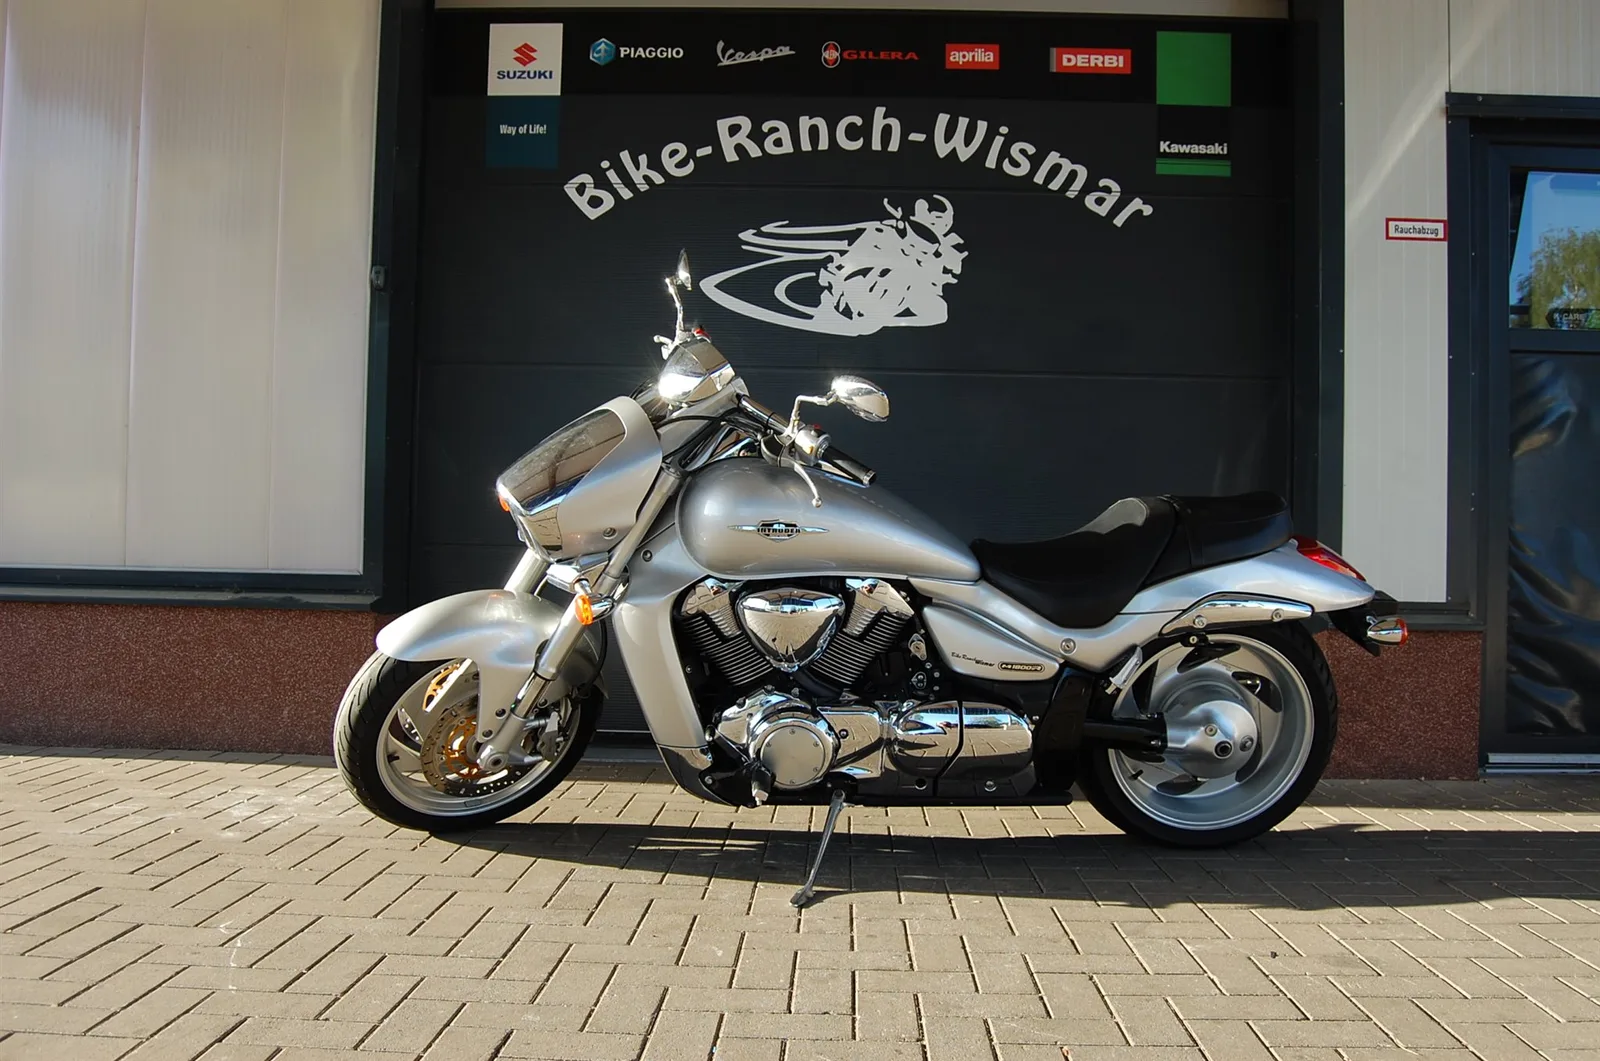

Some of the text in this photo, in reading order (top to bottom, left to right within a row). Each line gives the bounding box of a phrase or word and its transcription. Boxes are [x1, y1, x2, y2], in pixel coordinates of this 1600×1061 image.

[619, 46, 684, 59] PIAGGIO
[716, 39, 796, 67] Vespa
[842, 49, 919, 61] GILERA
[949, 48, 994, 64] aprilia
[1062, 54, 1124, 67] DERBI
[496, 70, 553, 80] SUZUKI
[499, 124, 547, 136] Way of Life!
[1159, 140, 1228, 155] Kawasaki
[563, 106, 1153, 228] Bike-Ranch-Wismar
[1394, 224, 1439, 237] Rauchabzug
